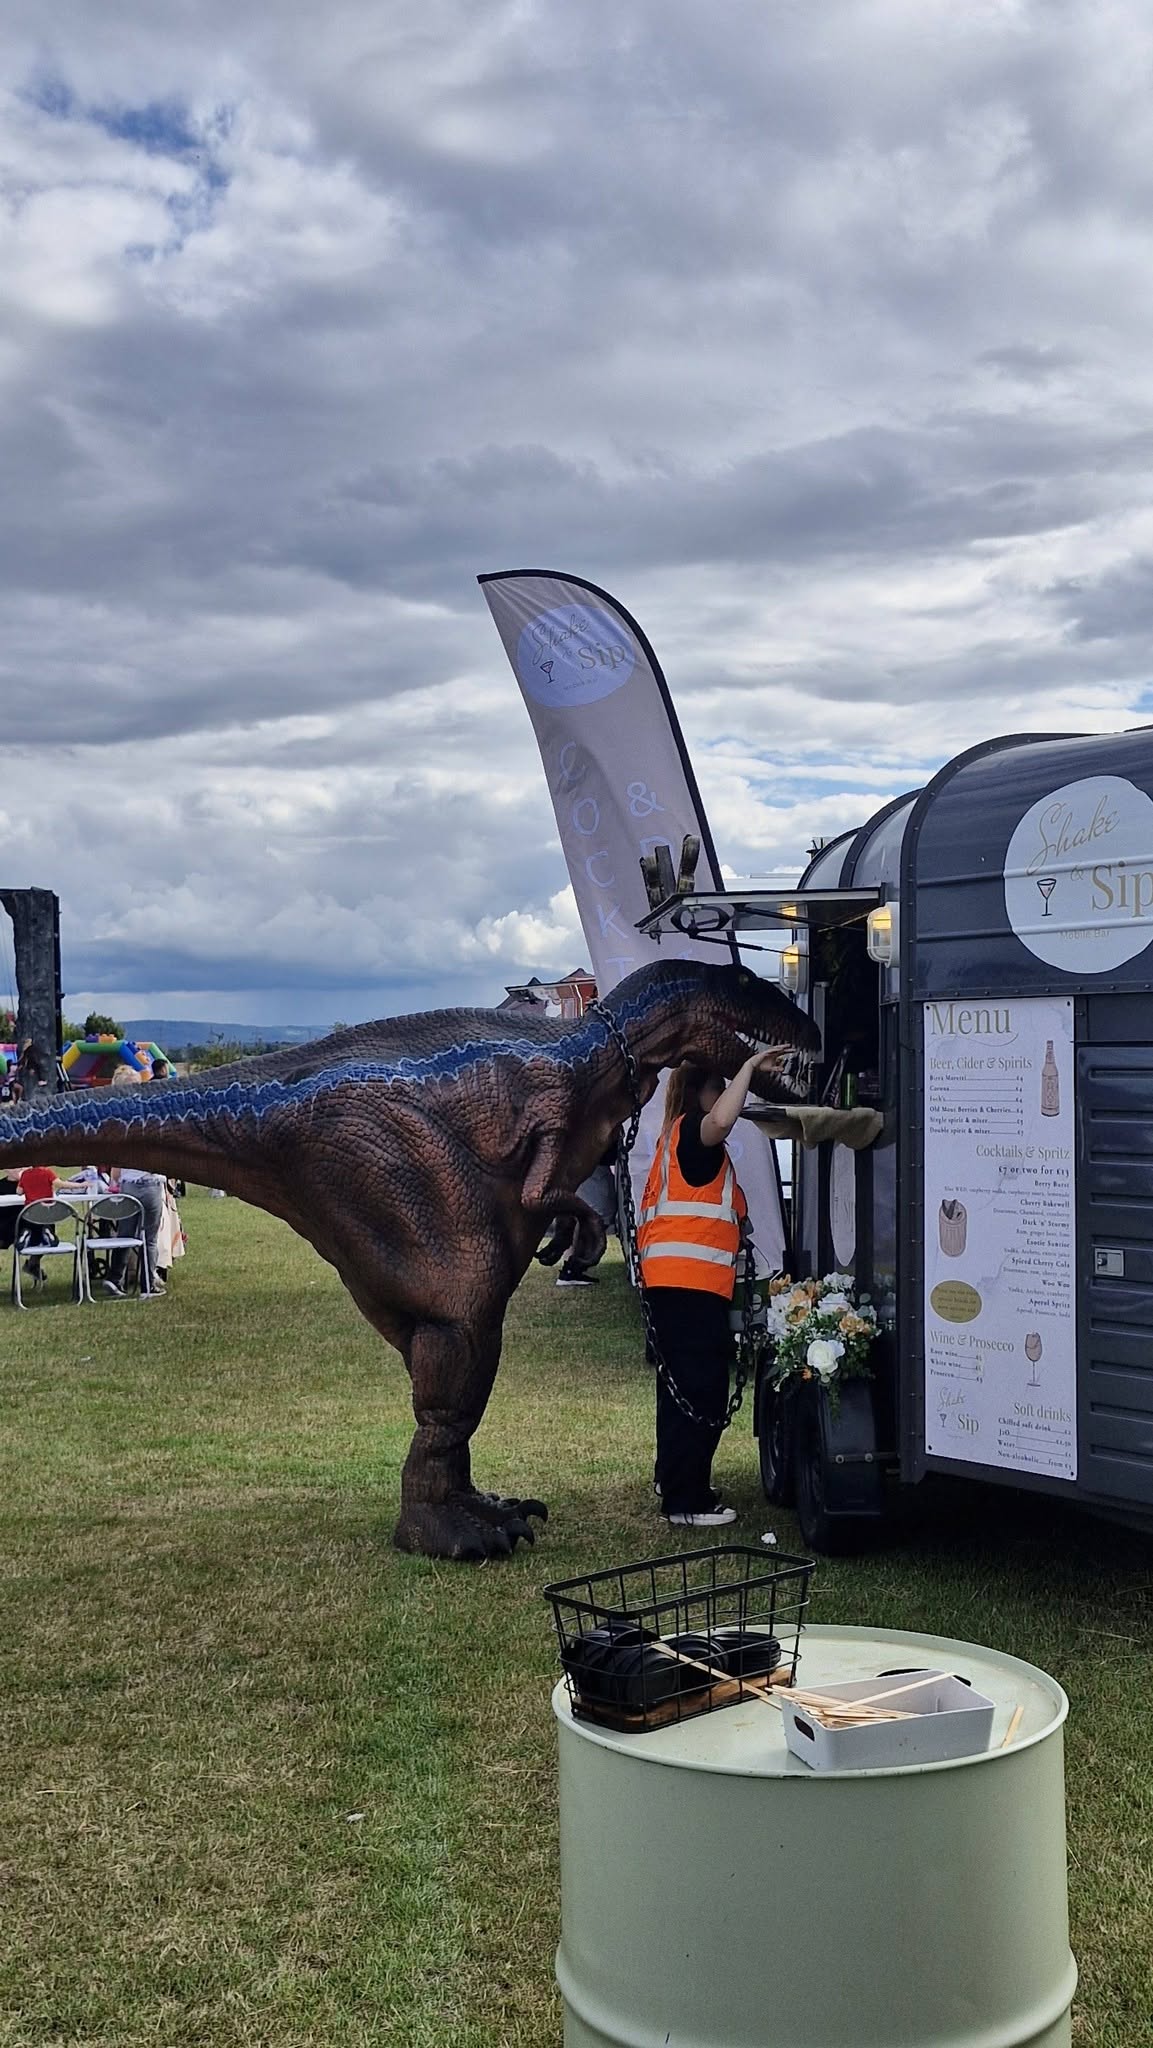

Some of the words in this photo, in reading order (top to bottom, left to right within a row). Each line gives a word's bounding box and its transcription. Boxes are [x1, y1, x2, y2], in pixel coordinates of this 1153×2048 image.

[532, 614, 590, 665] Shake
[578, 642, 625, 671] Sip
[627, 781, 665, 817] &
[1026, 795, 1120, 875] Shake
[1091, 860, 1153, 917] Sip
[930, 1003, 1012, 1035] Menu
[930, 1058, 954, 1070] Beer,
[956, 1057, 984, 1069] Cider
[987, 1057, 997, 1069] &
[998, 1056, 1033, 1071] Spirits
[929, 1126, 949, 1134] Double
[976, 1144, 1023, 1158] Cocktails
[1025, 1146, 1035, 1158] &
[1038, 1146, 1070, 1161] Spritz
[1010, 1166, 1019, 1174] or
[1040, 1165, 1053, 1175] for
[1022, 1218, 1037, 1226] Dark
[1011, 1257, 1032, 1266] Spiced
[1033, 1259, 1054, 1268] Cherry
[1055, 1260, 1070, 1268] Cola
[1029, 1298, 1050, 1307] Aperol
[930, 1330, 955, 1345] Wine
[957, 1334, 967, 1345] &
[969, 1335, 1014, 1353] Prosecco
[1014, 1402, 1034, 1416] Soft
[1037, 1404, 1072, 1422] drinks
[957, 1413, 980, 1434] Sip
[1034, 1423, 1051, 1432] drink
